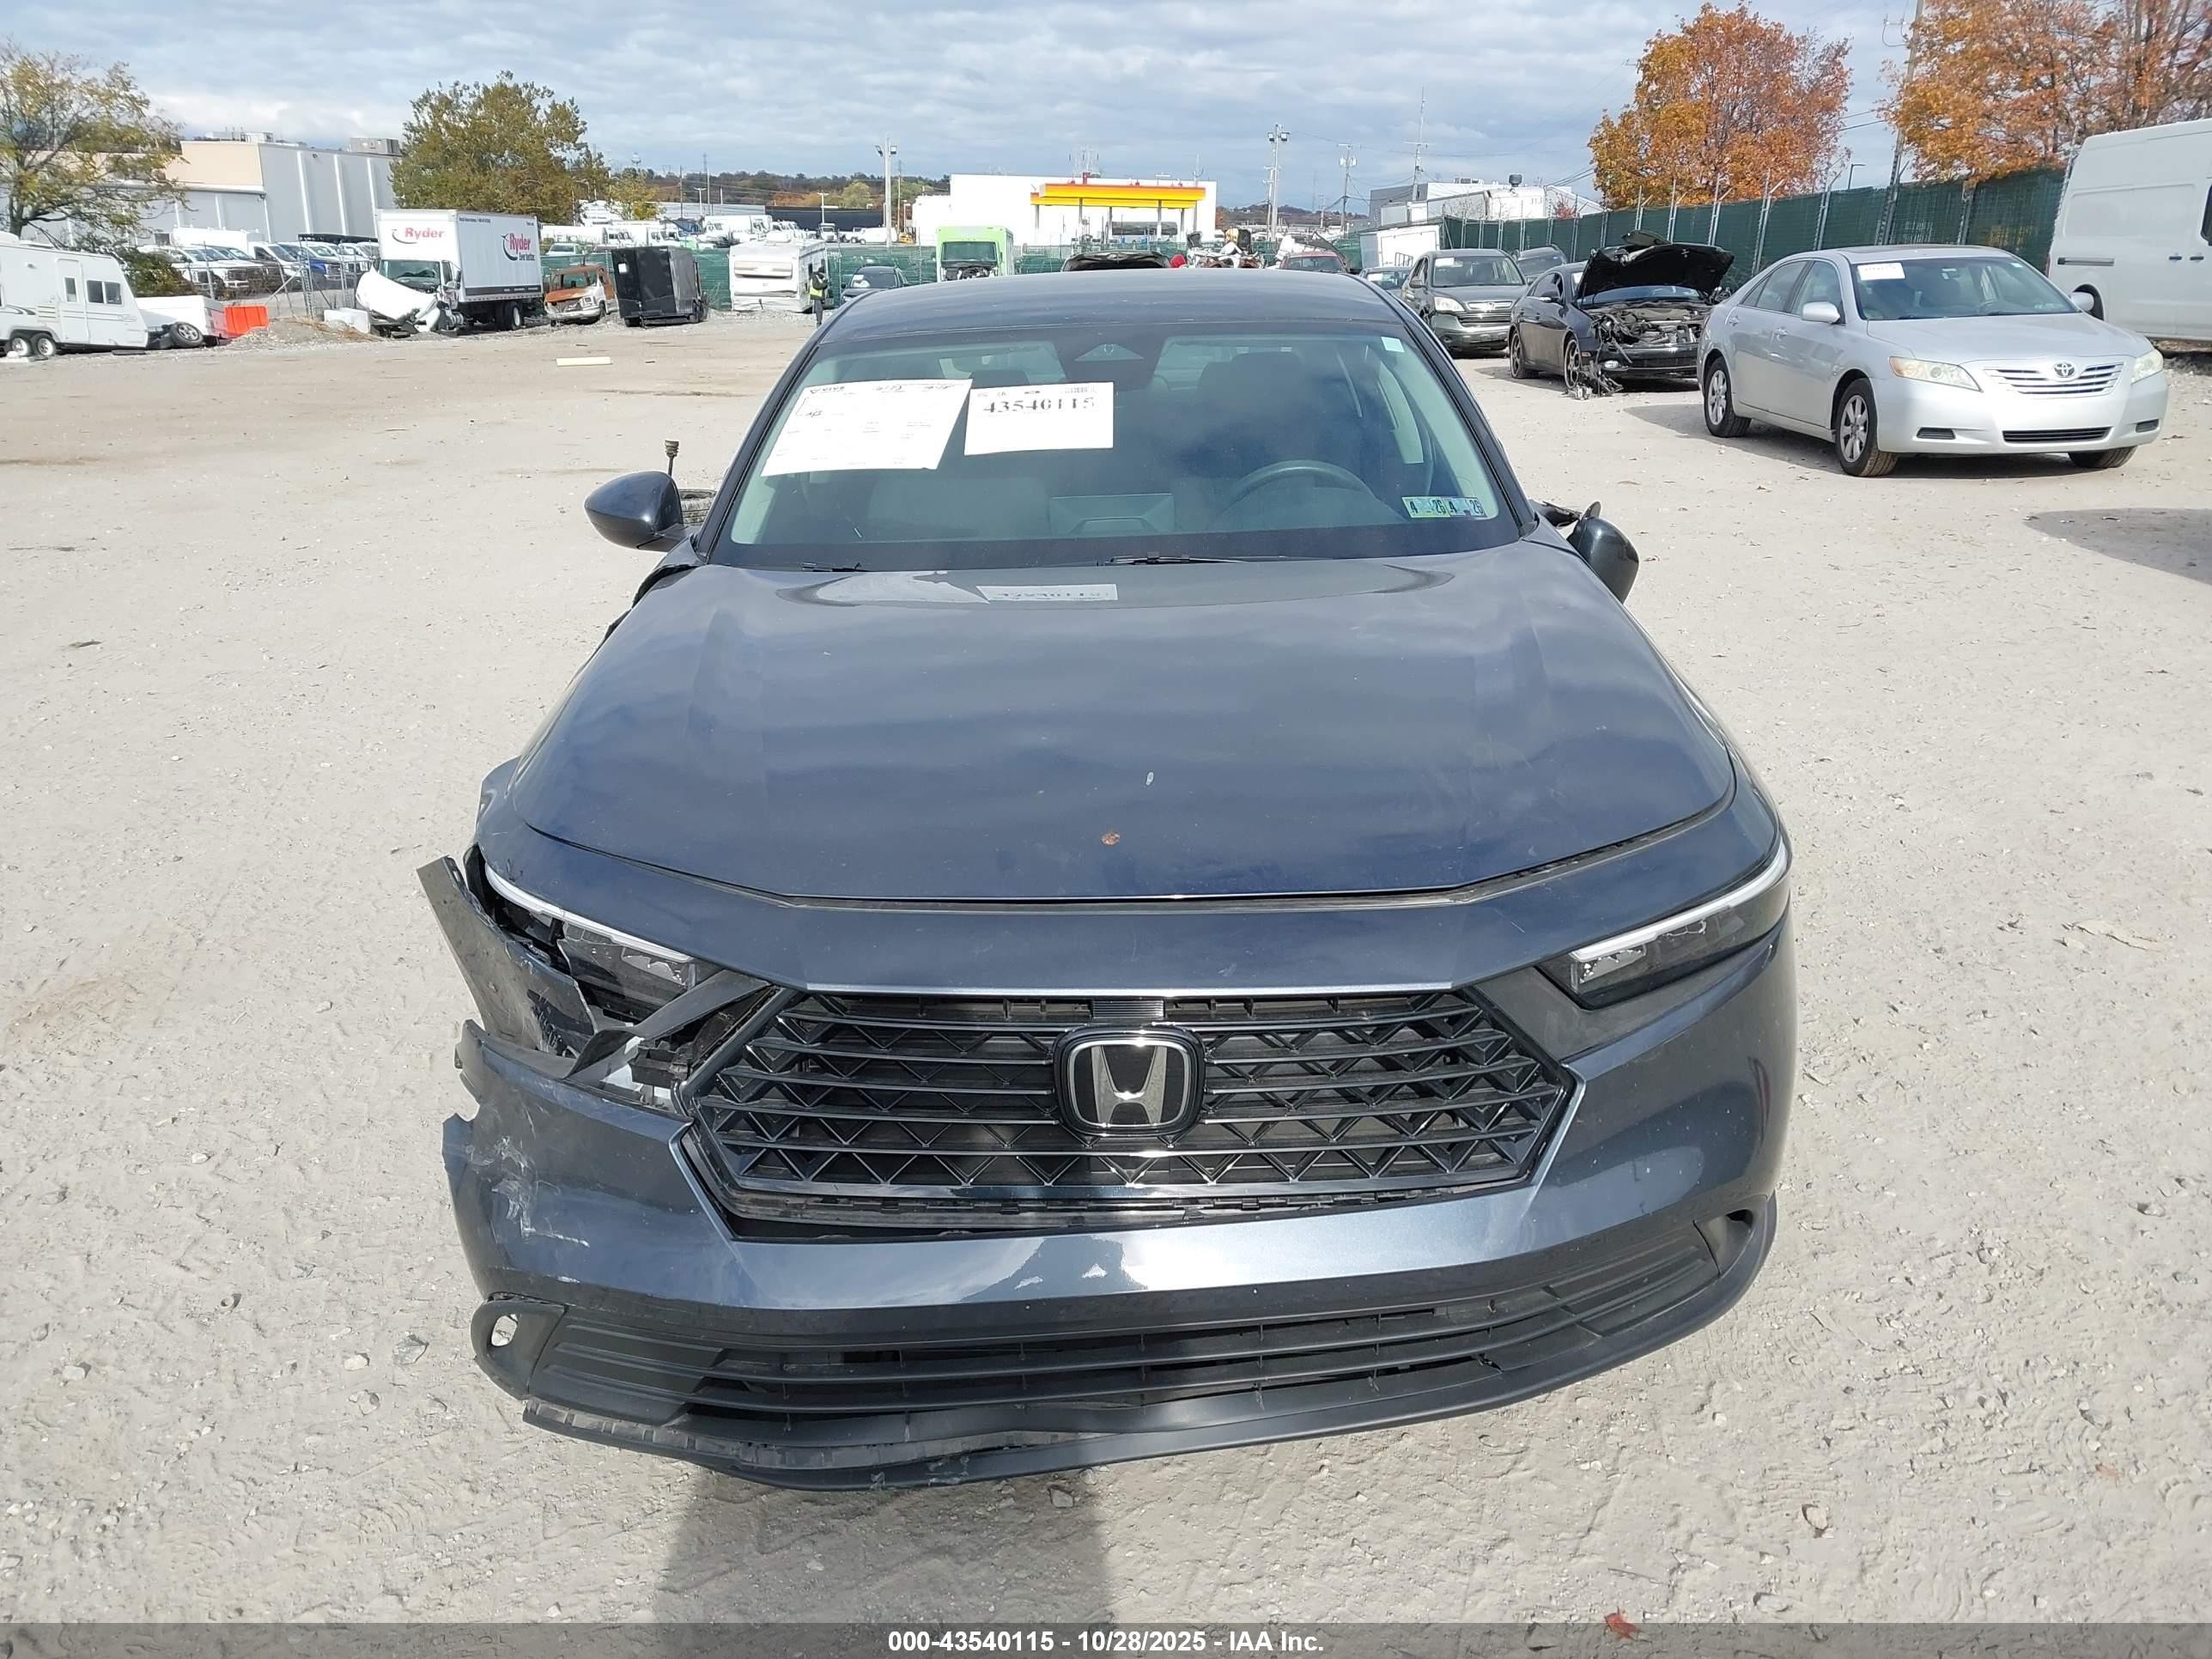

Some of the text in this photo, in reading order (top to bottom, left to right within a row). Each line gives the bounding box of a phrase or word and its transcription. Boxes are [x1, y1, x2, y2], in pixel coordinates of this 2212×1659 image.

[404, 228, 444, 240] Ryder
[509, 233, 531, 254] Ryder
[982, 397, 1095, 413] 43540115
